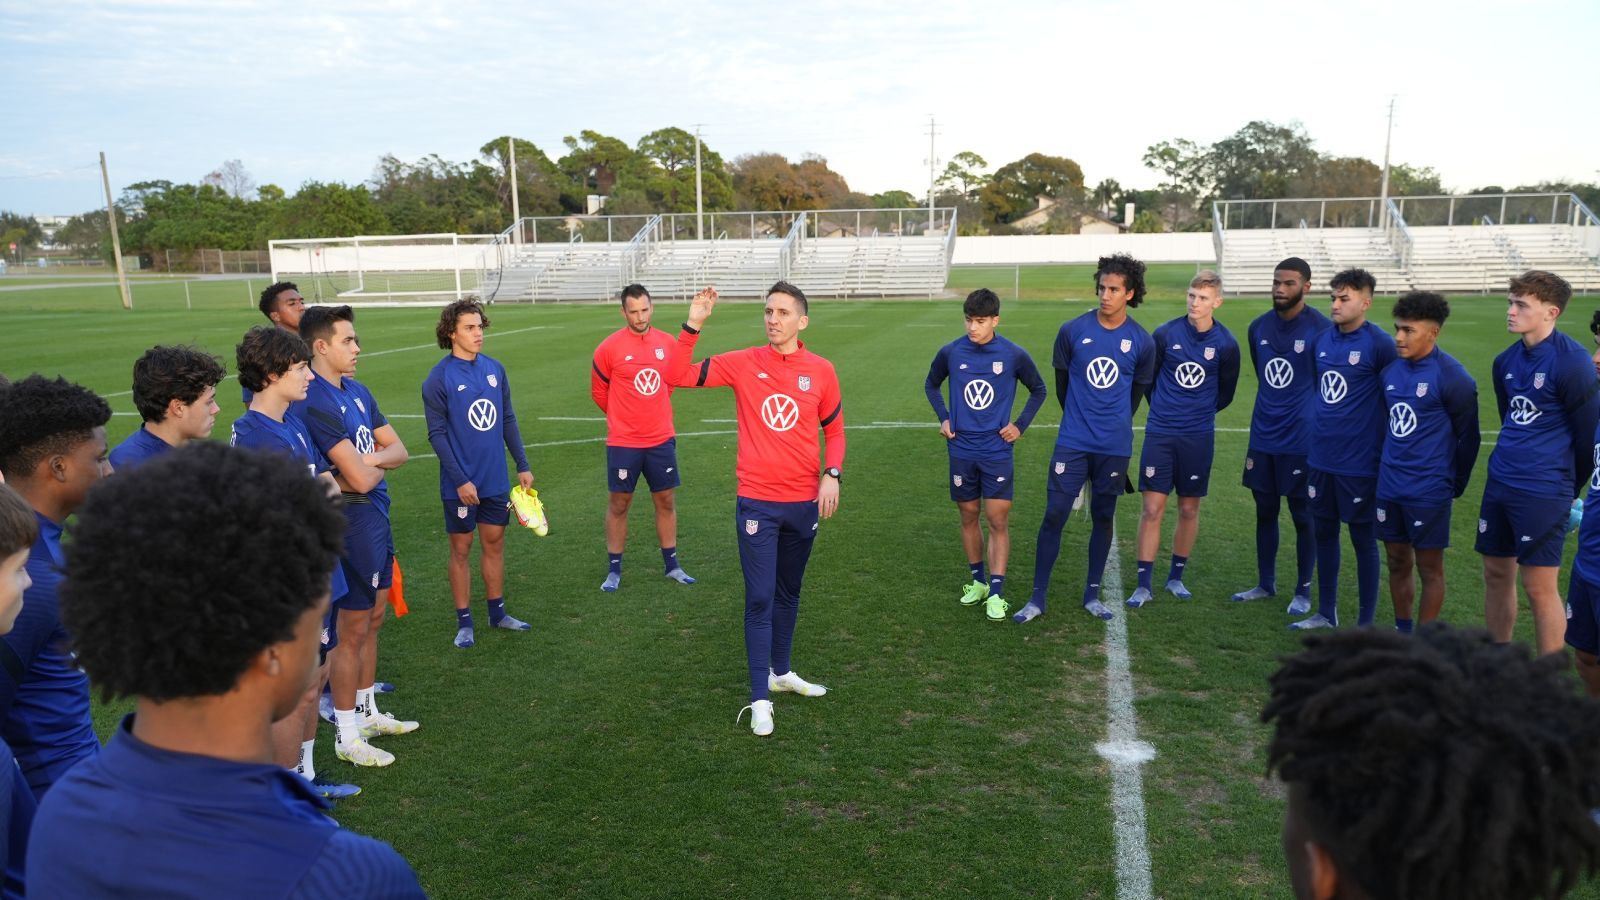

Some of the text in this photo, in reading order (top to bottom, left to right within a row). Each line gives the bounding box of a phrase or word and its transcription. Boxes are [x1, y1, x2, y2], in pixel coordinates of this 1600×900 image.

[634, 368, 661, 396] VW
[1086, 356, 1119, 389] VW
[1175, 361, 1206, 389] VW
[1264, 357, 1294, 389] VW
[1320, 370, 1348, 404] VW
[964, 379, 994, 410] VW
[468, 398, 497, 431] VW
[761, 393, 799, 432] VW
[1389, 402, 1417, 437] VW
